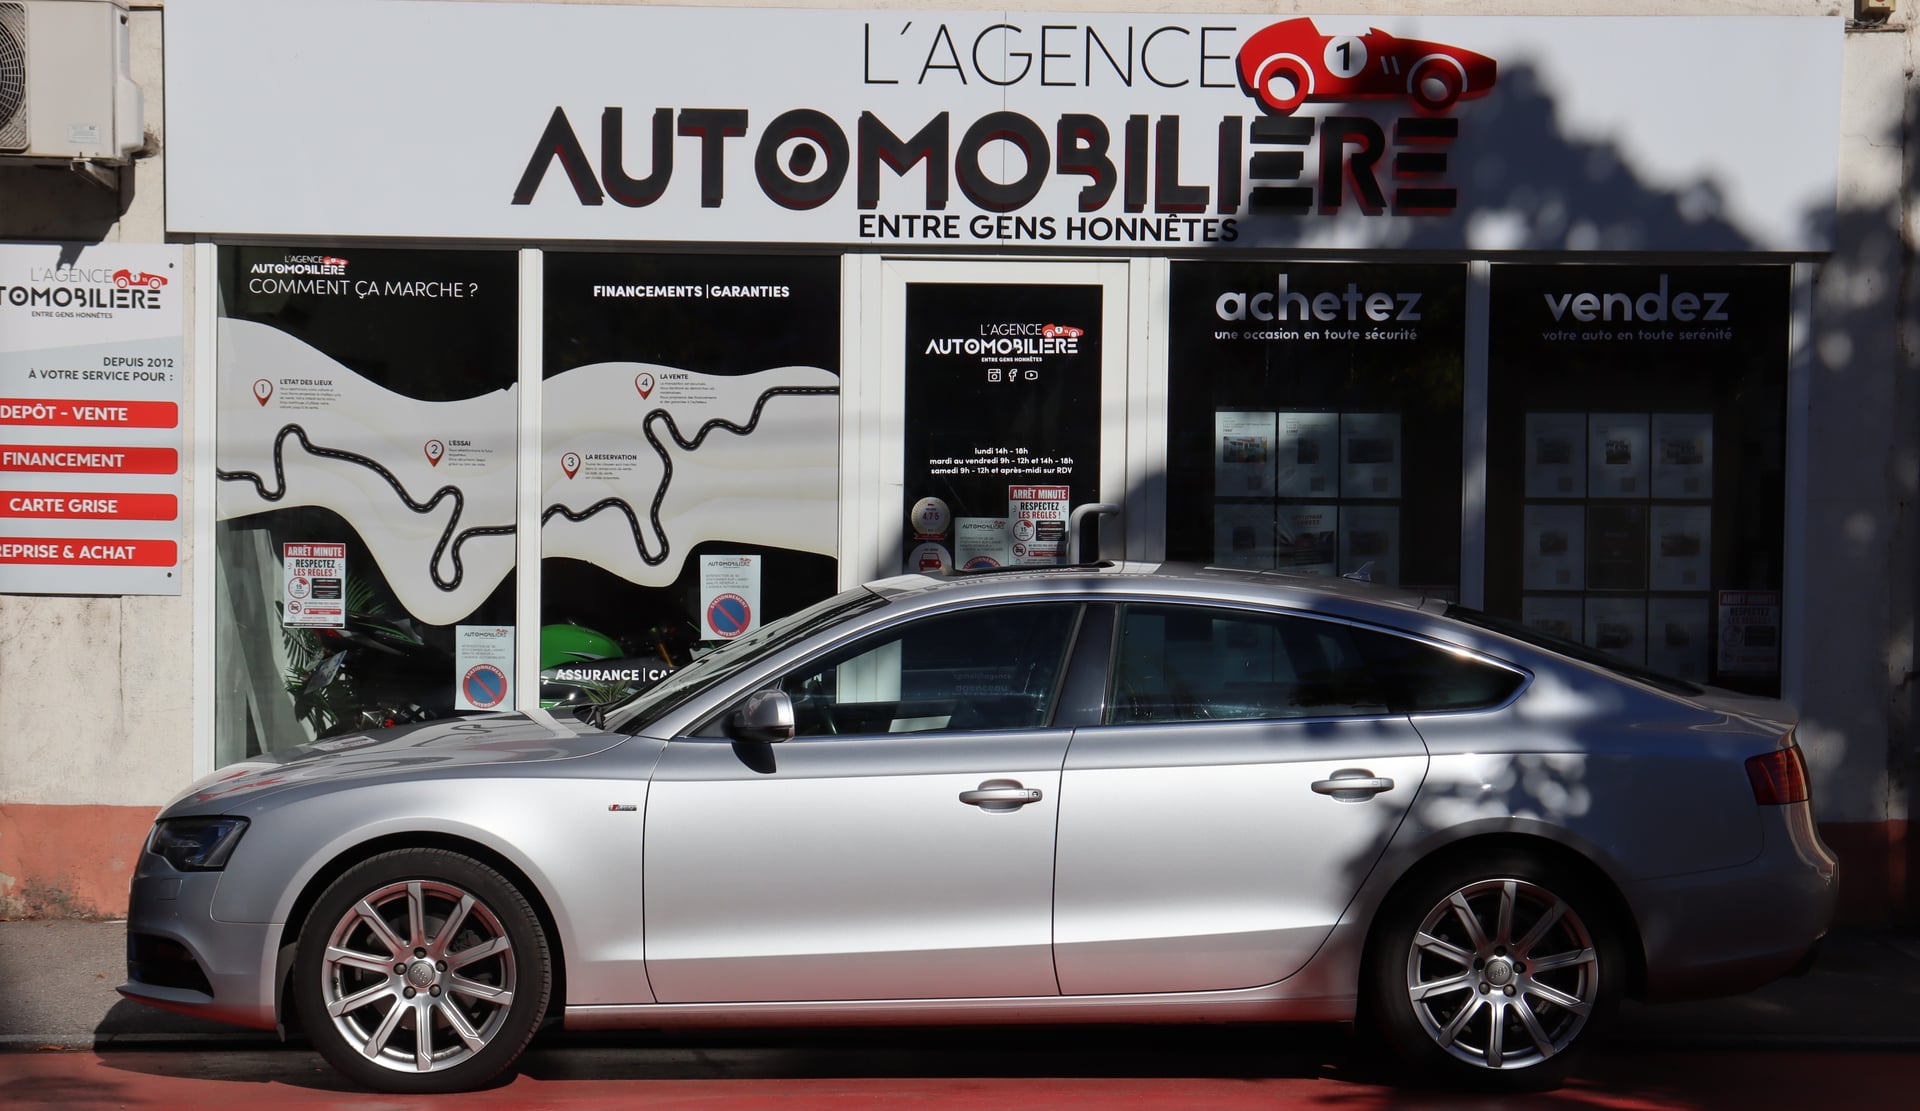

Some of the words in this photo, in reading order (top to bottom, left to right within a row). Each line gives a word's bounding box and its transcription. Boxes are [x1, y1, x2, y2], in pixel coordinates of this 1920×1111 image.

[864, 21, 1237, 89] L'AGENCE
[1335, 42, 1351, 71] 1
[859, 214, 960, 238] ENTRE
[969, 215, 1057, 240] GENS
[1066, 213, 1239, 243] HONNÊTES
[249, 278, 350, 295] COMMENT
[355, 280, 380, 299] ÇA
[385, 281, 464, 298] MARCHE
[469, 282, 479, 297] ?
[593, 285, 703, 297] FINANCEMENTS
[711, 285, 790, 297] GARANTIES
[1215, 273, 1423, 321] achetez
[1543, 273, 1730, 322] vendez
[980, 323, 1042, 336] L'AGENCE
[1214, 330, 1239, 340] une
[1243, 328, 1299, 340] occasion
[1303, 330, 1320, 340] en
[1325, 328, 1360, 340] toute
[1365, 327, 1418, 340] sécurité
[1542, 329, 1577, 341] votre
[1582, 329, 1613, 341] auto
[1617, 331, 1633, 341] en
[1638, 329, 1674, 341] toute
[103, 357, 144, 367] DEPUIS
[147, 358, 174, 368] 2012
[28, 368, 37, 379] À
[40, 369, 79, 380] VOTRE
[82, 370, 130, 381] SERVICE
[132, 371, 166, 382] POUR
[641, 377, 648, 386] 4
[0, 403, 56, 420] DEPÔT
[72, 406, 129, 422] VENTE
[431, 444, 438, 454] 2
[3, 451, 125, 467] FINANCEMENT
[568, 457, 575, 467] 3
[1000, 466, 1042, 475] après-midi
[1056, 466, 1073, 474] RDV
[1038, 489, 1067, 500] MINUTE
[9, 498, 64, 512] CARTE
[68, 499, 118, 513] GRISE
[1020, 502, 1060, 511] RESPECTEZ
[1018, 511, 1031, 519] LES
[0, 543, 58, 558] EPRISE
[62, 546, 75, 559] &
[79, 546, 136, 560] ACHAT
[313, 547, 343, 557] MINUTE
[295, 559, 335, 568] RESPECTEZ
[293, 568, 306, 576] LES
[555, 669, 640, 681] ASSURANCE
